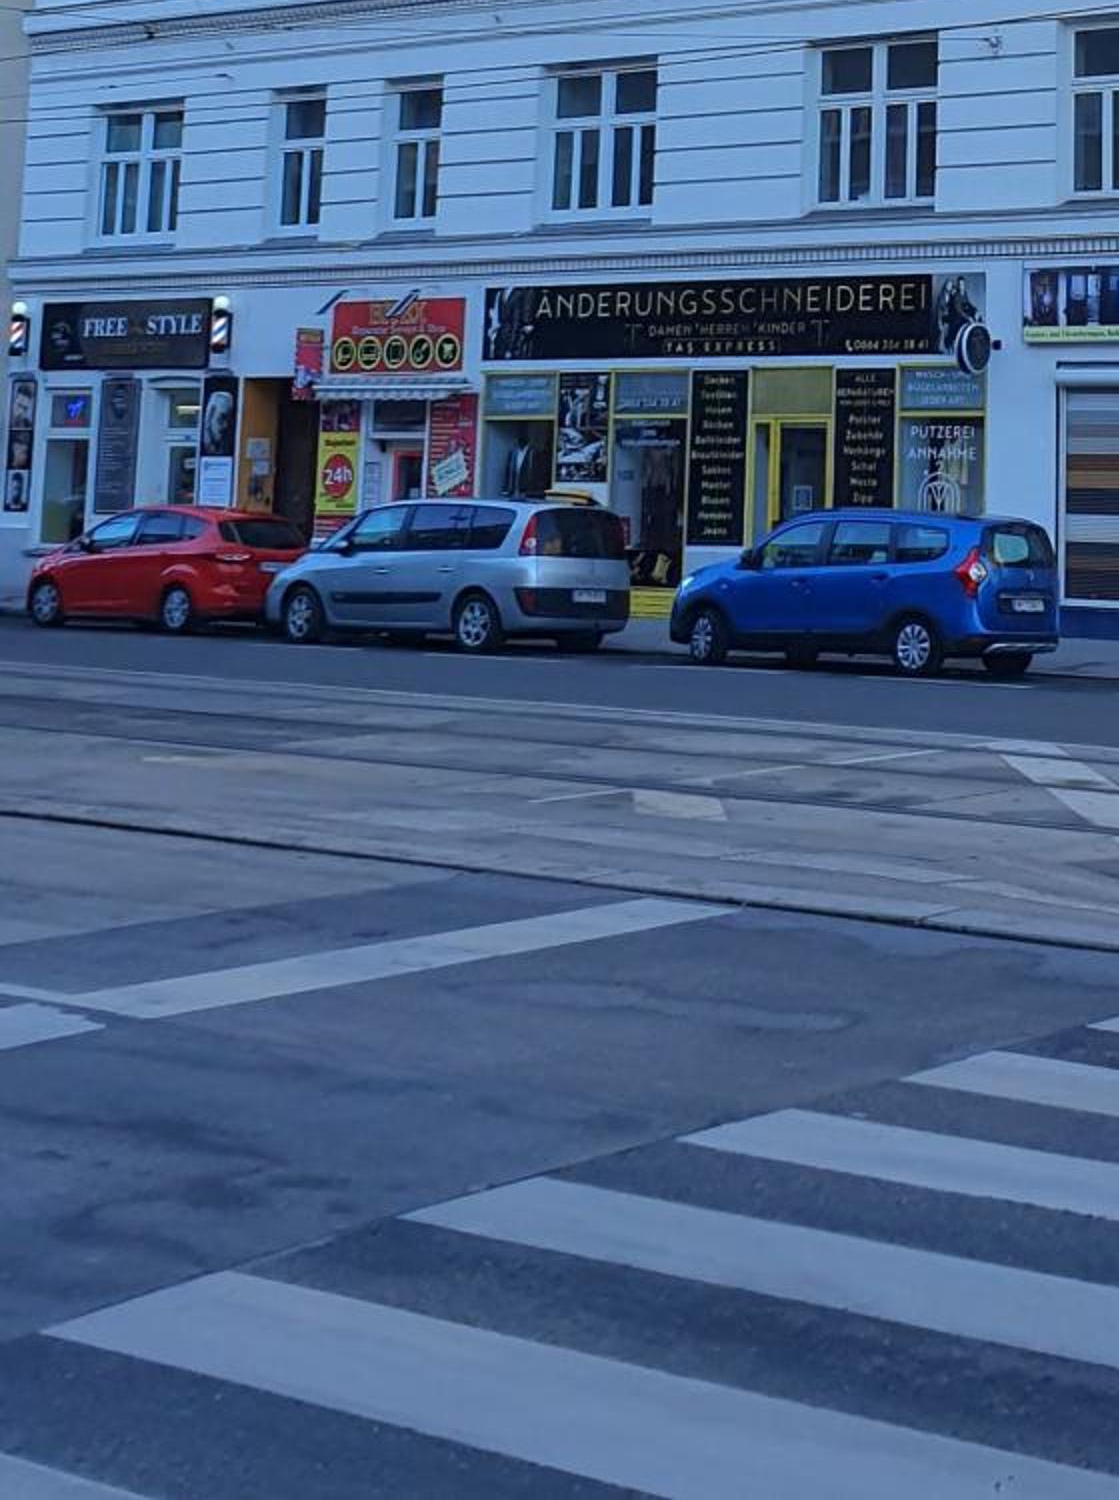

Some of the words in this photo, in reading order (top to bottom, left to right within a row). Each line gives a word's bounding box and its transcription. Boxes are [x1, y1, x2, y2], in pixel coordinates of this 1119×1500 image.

[536, 284, 927, 318] ÄNDERUNGSSCHNEIDEREI
[82, 317, 129, 337] FREE
[144, 314, 202, 335] STYLE
[648, 323, 692, 336] DAMEN
[911, 425, 975, 439] PUTZEREI
[907, 447, 977, 460] ANNAHME
[325, 466, 353, 485] 24h
